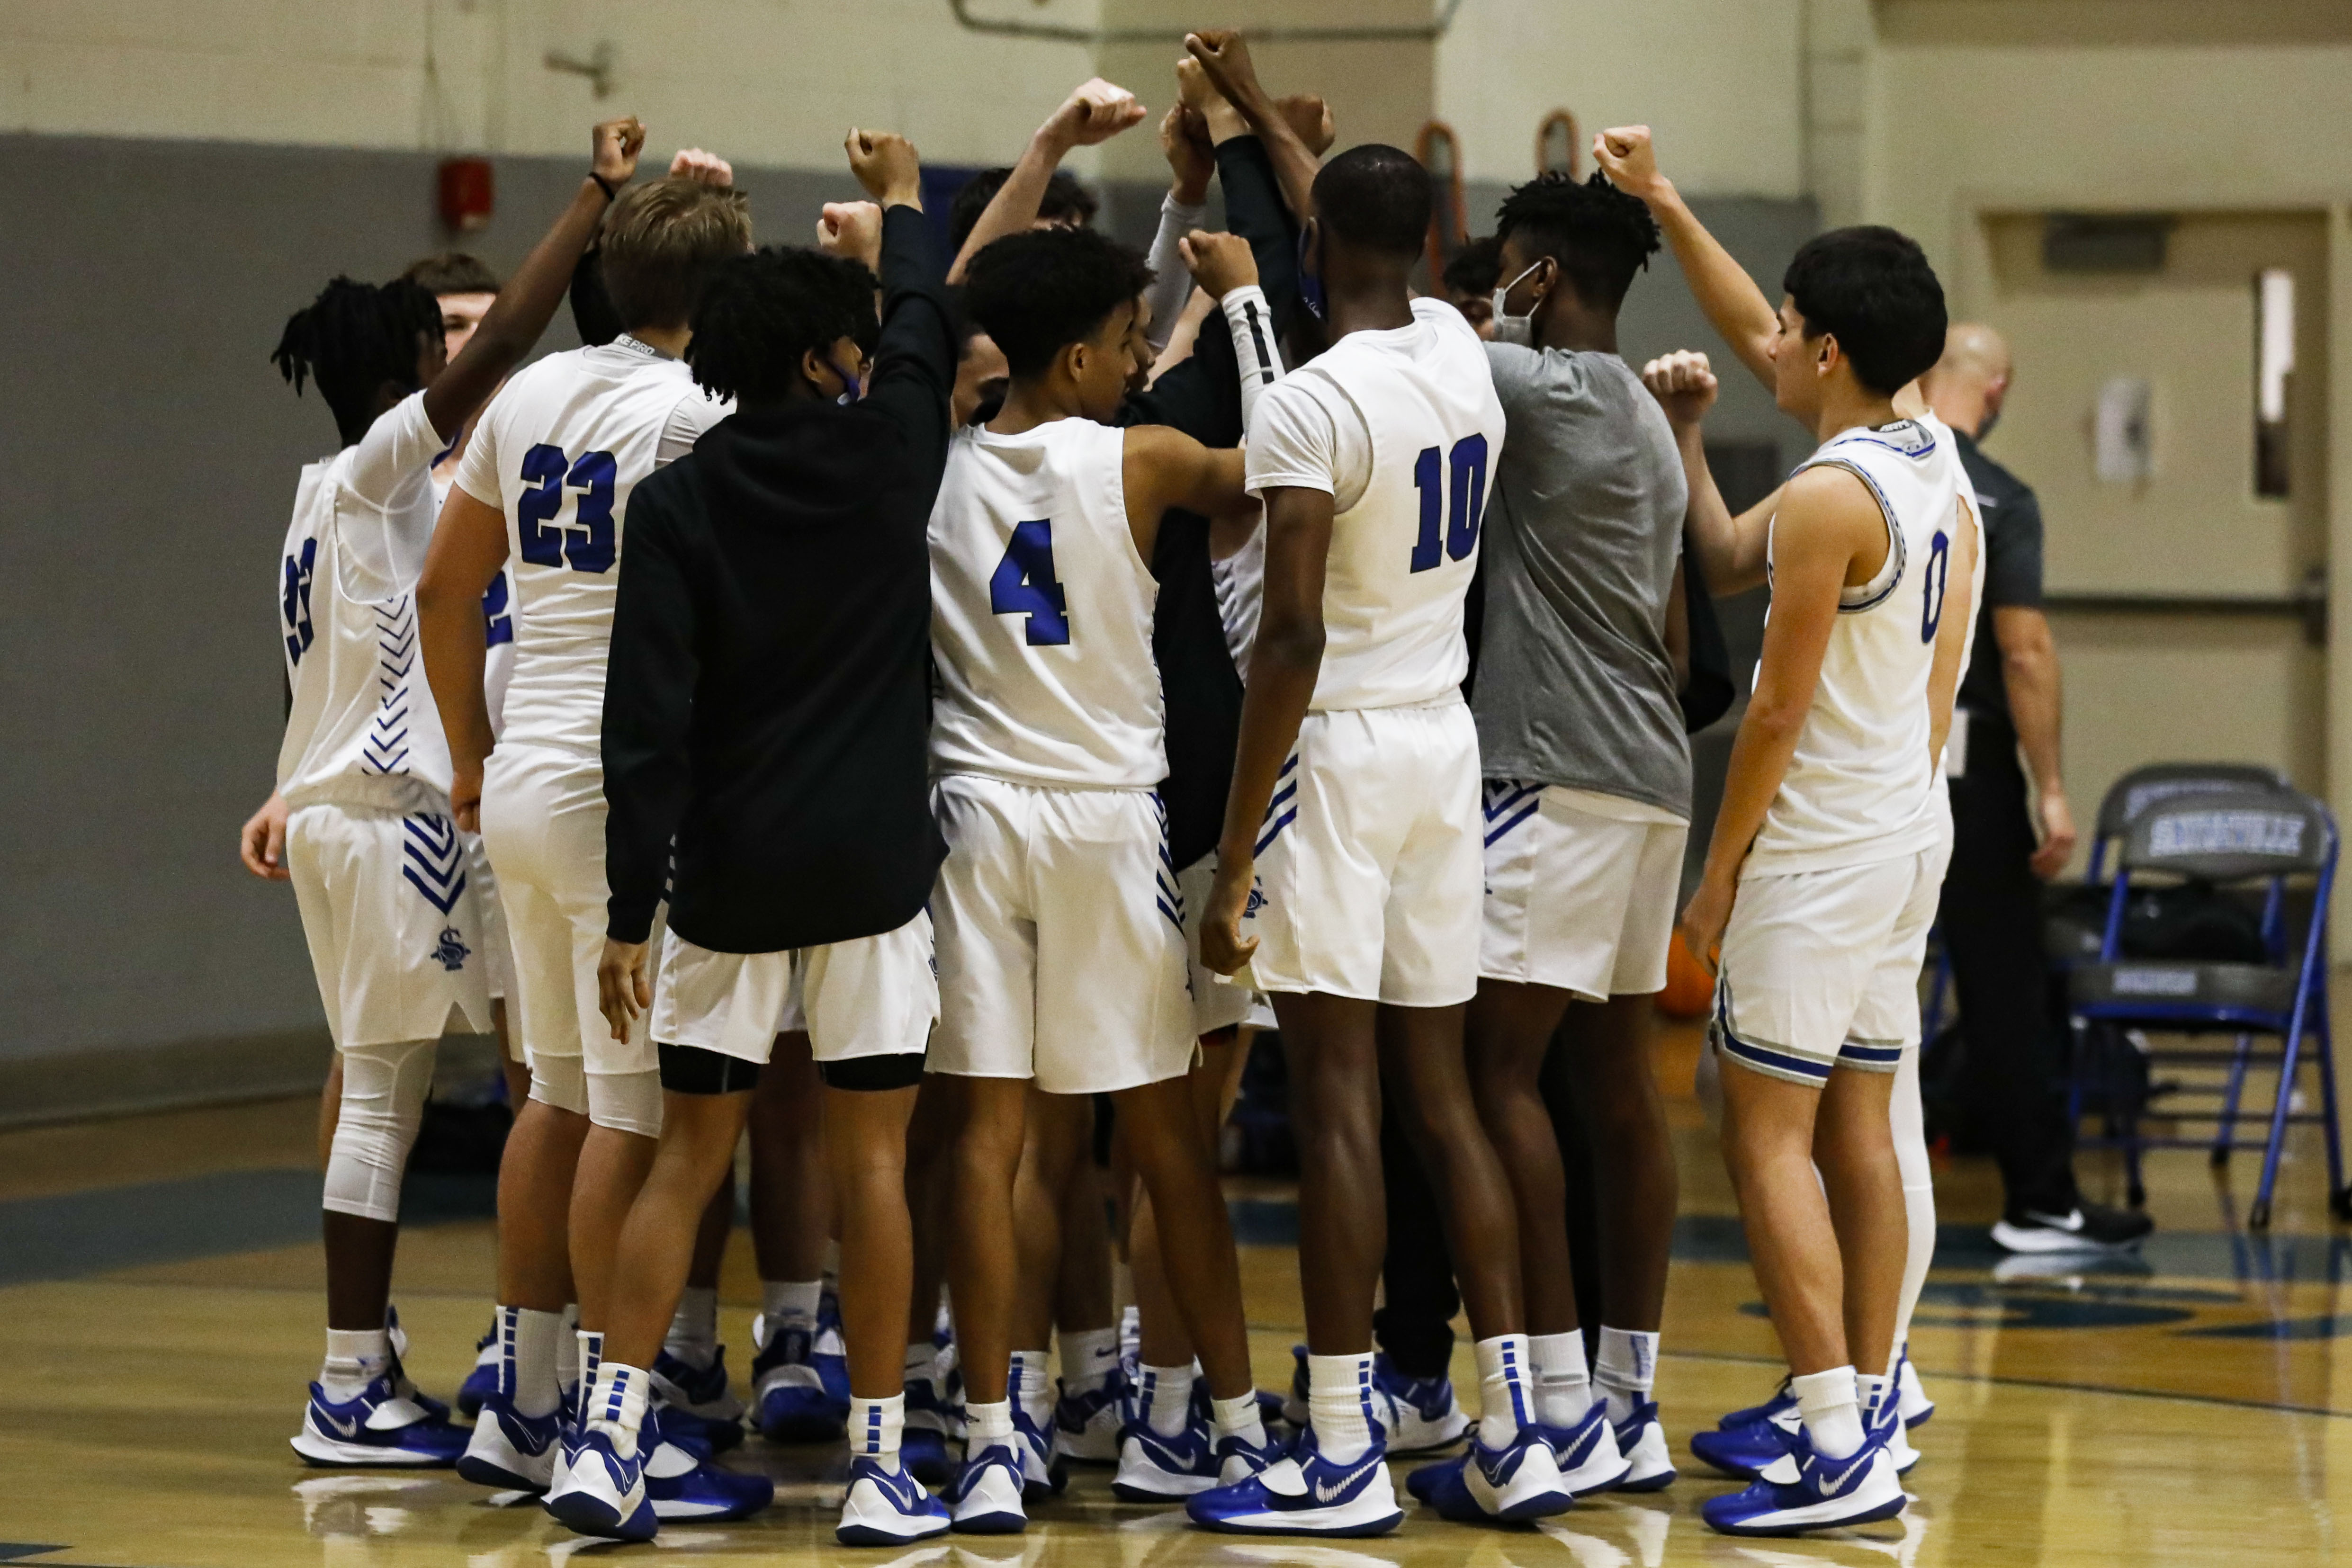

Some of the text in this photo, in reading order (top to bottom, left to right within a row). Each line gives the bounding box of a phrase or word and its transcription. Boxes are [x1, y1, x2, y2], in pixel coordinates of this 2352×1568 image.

[629, 340, 655, 355] PRO
[518, 443, 617, 573] 23
[1410, 432, 1487, 574] 10
[989, 518, 1070, 646] 4
[1922, 529, 1948, 645] 0
